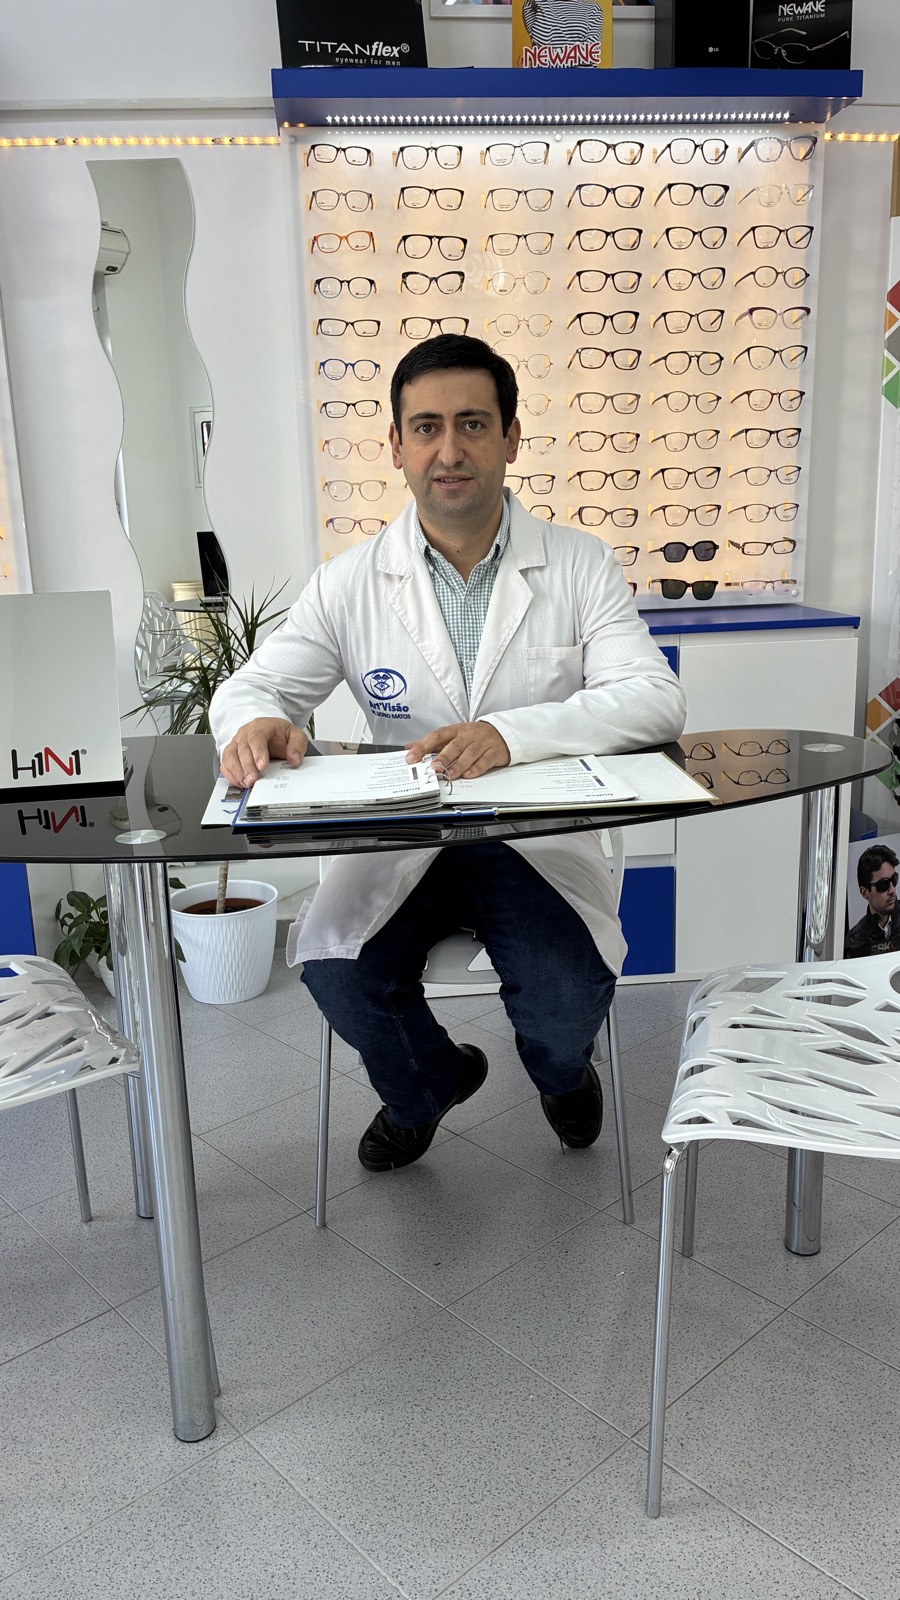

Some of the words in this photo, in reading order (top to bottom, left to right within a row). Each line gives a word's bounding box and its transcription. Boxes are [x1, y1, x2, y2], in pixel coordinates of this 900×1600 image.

[778, 0, 826, 16] NEWAVE
[335, 57, 367, 65] eyewear
[370, 58, 383, 66] for
[523, 41, 601, 68] NEWAVE
